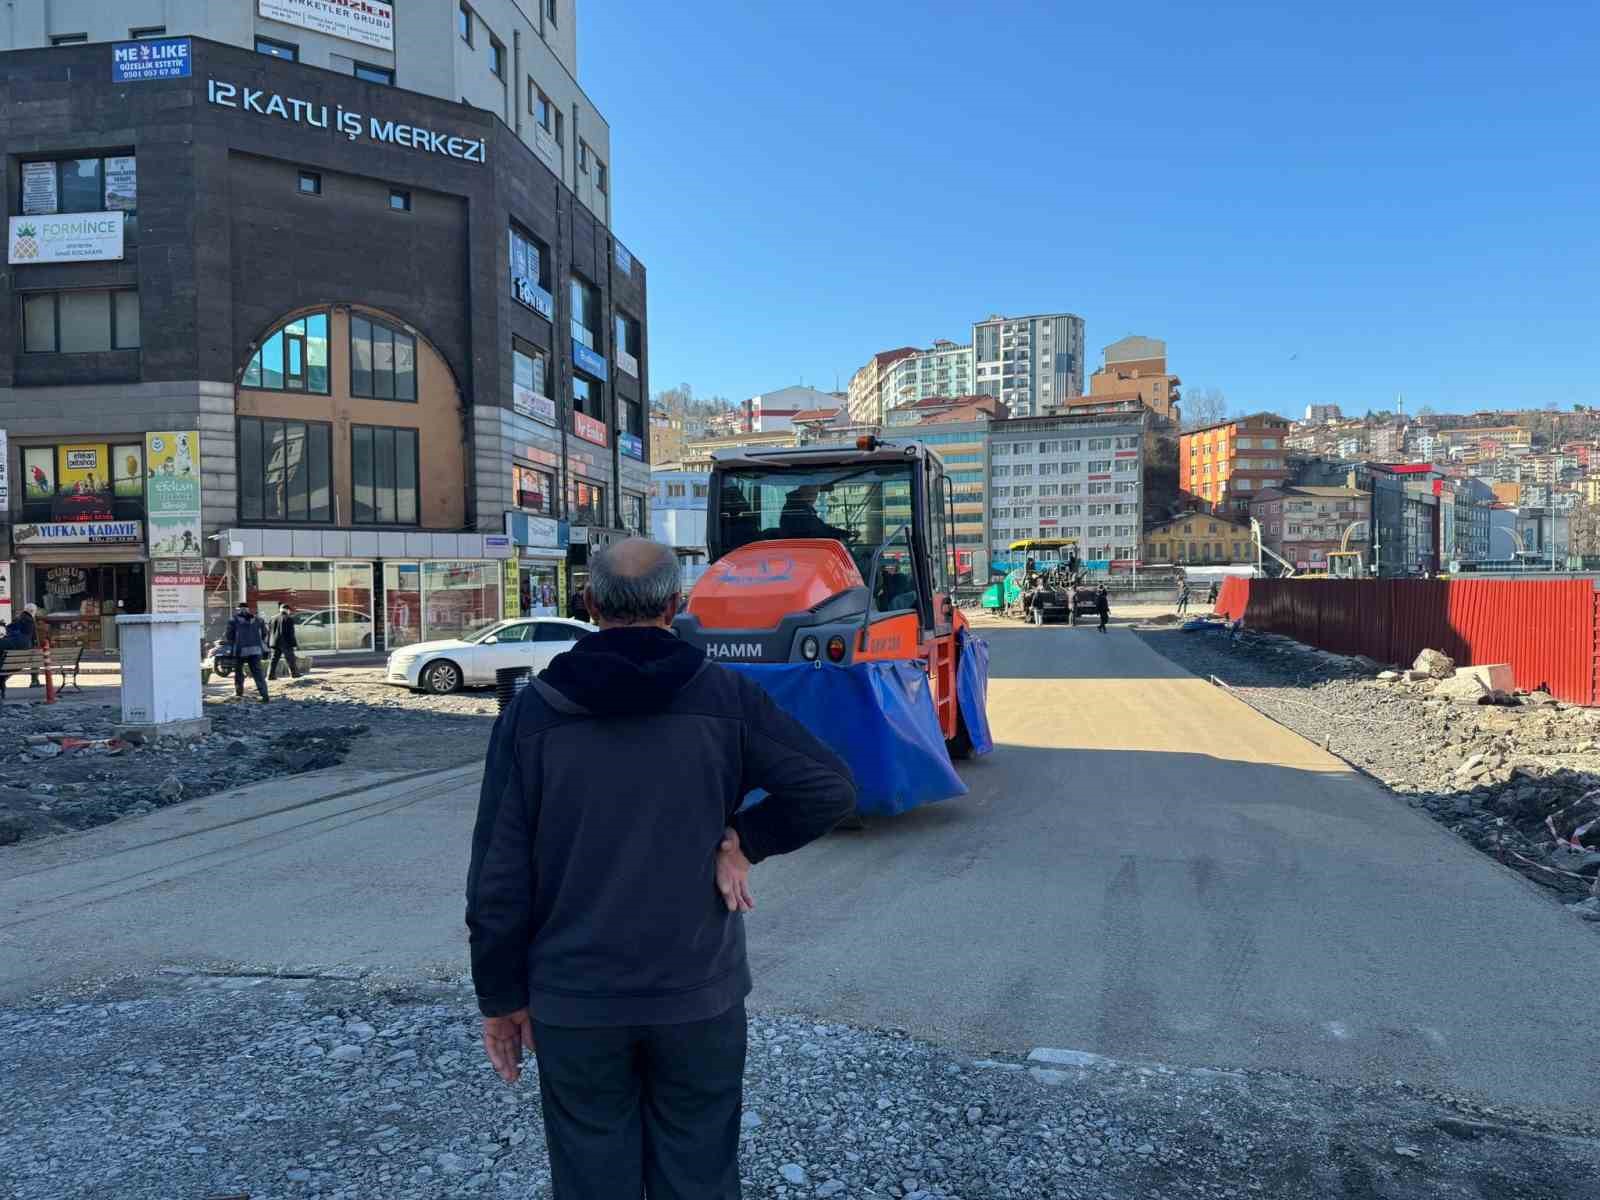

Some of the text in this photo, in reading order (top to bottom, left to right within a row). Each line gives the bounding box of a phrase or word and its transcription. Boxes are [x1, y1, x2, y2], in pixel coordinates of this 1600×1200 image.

[353, 12, 390, 29] GRUBU
[114, 48, 138, 61] ME
[208, 79, 486, 163] 12 KATLI İŞ MERKEZİ
[43, 220, 116, 235] FORMİNCE
[40, 524, 77, 537] YUFKA
[88, 523, 136, 536] KADAYIF
[706, 643, 762, 657] HAMM
